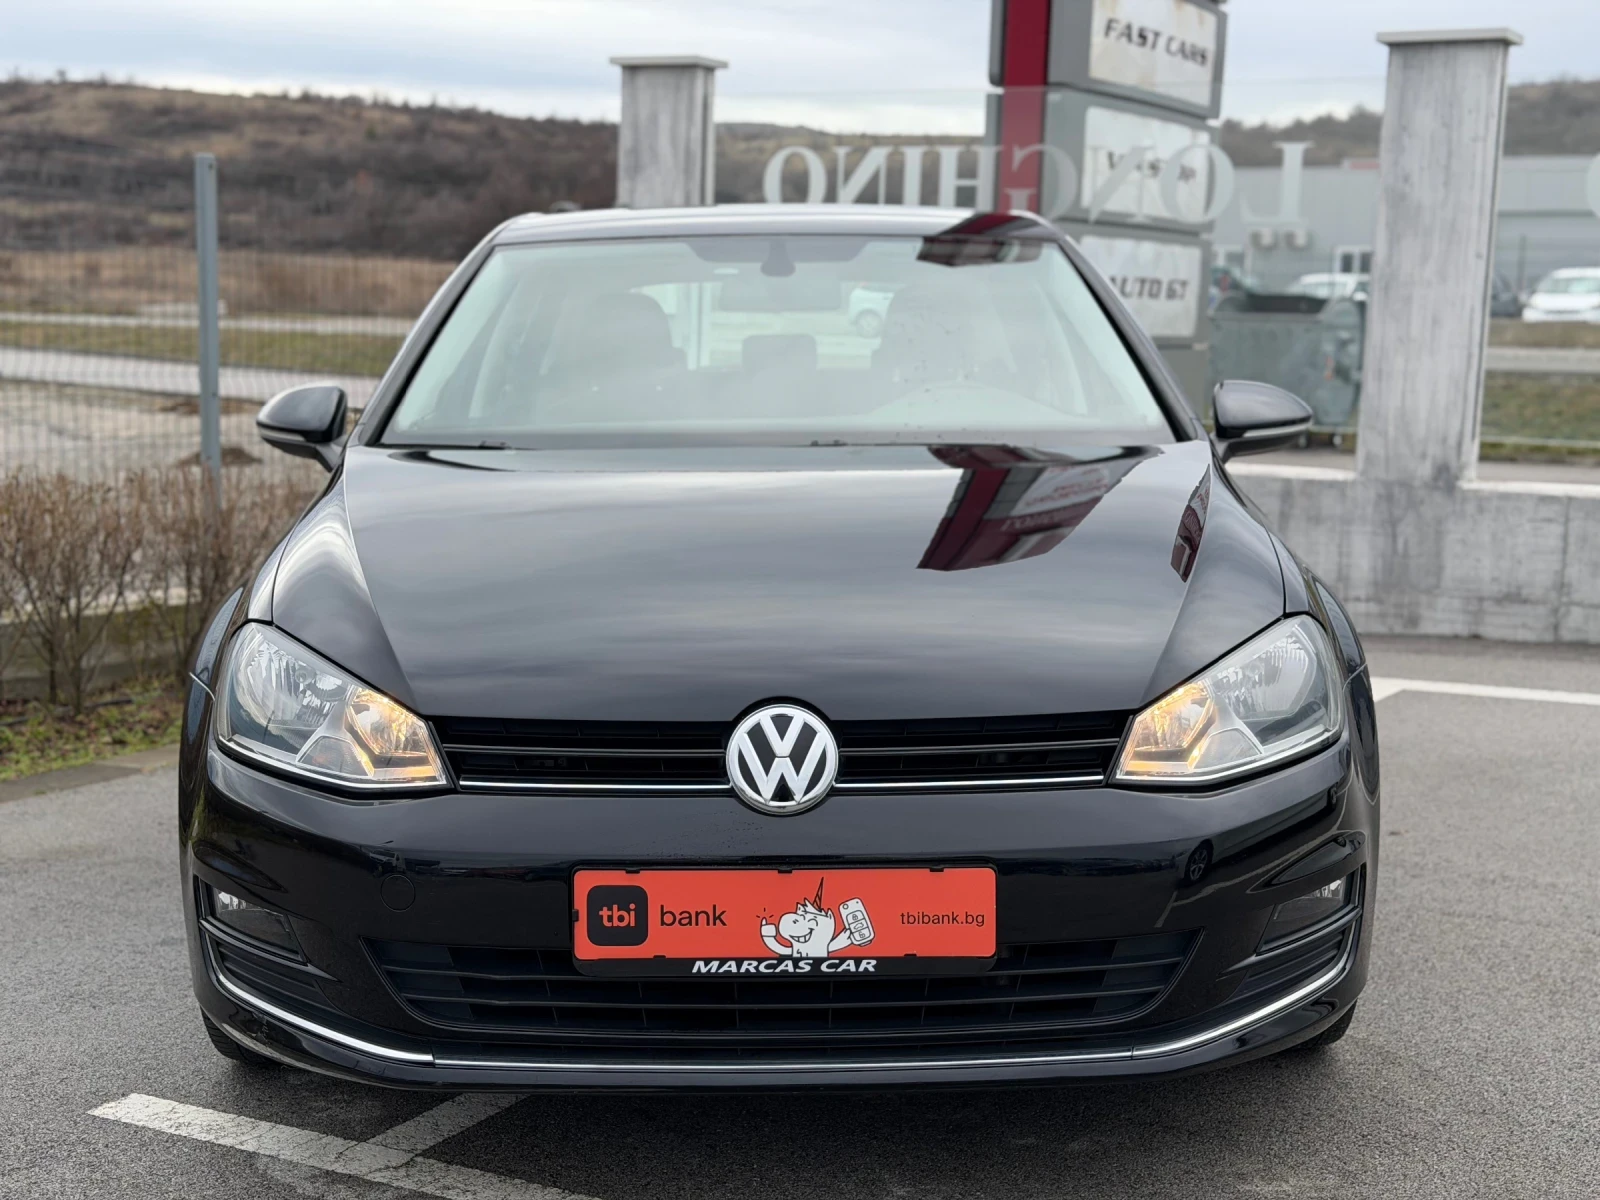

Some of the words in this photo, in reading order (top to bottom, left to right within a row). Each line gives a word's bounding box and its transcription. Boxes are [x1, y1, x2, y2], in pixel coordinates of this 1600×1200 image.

[1104, 18, 1161, 50] FAST
[1165, 35, 1208, 66] CARS
[732, 709, 833, 808] VW
[599, 903, 636, 927] tbi
[660, 904, 728, 927] bank
[900, 911, 985, 928] tbibank.bg
[691, 959, 813, 974] MARCAS
[819, 959, 877, 973] CAR
